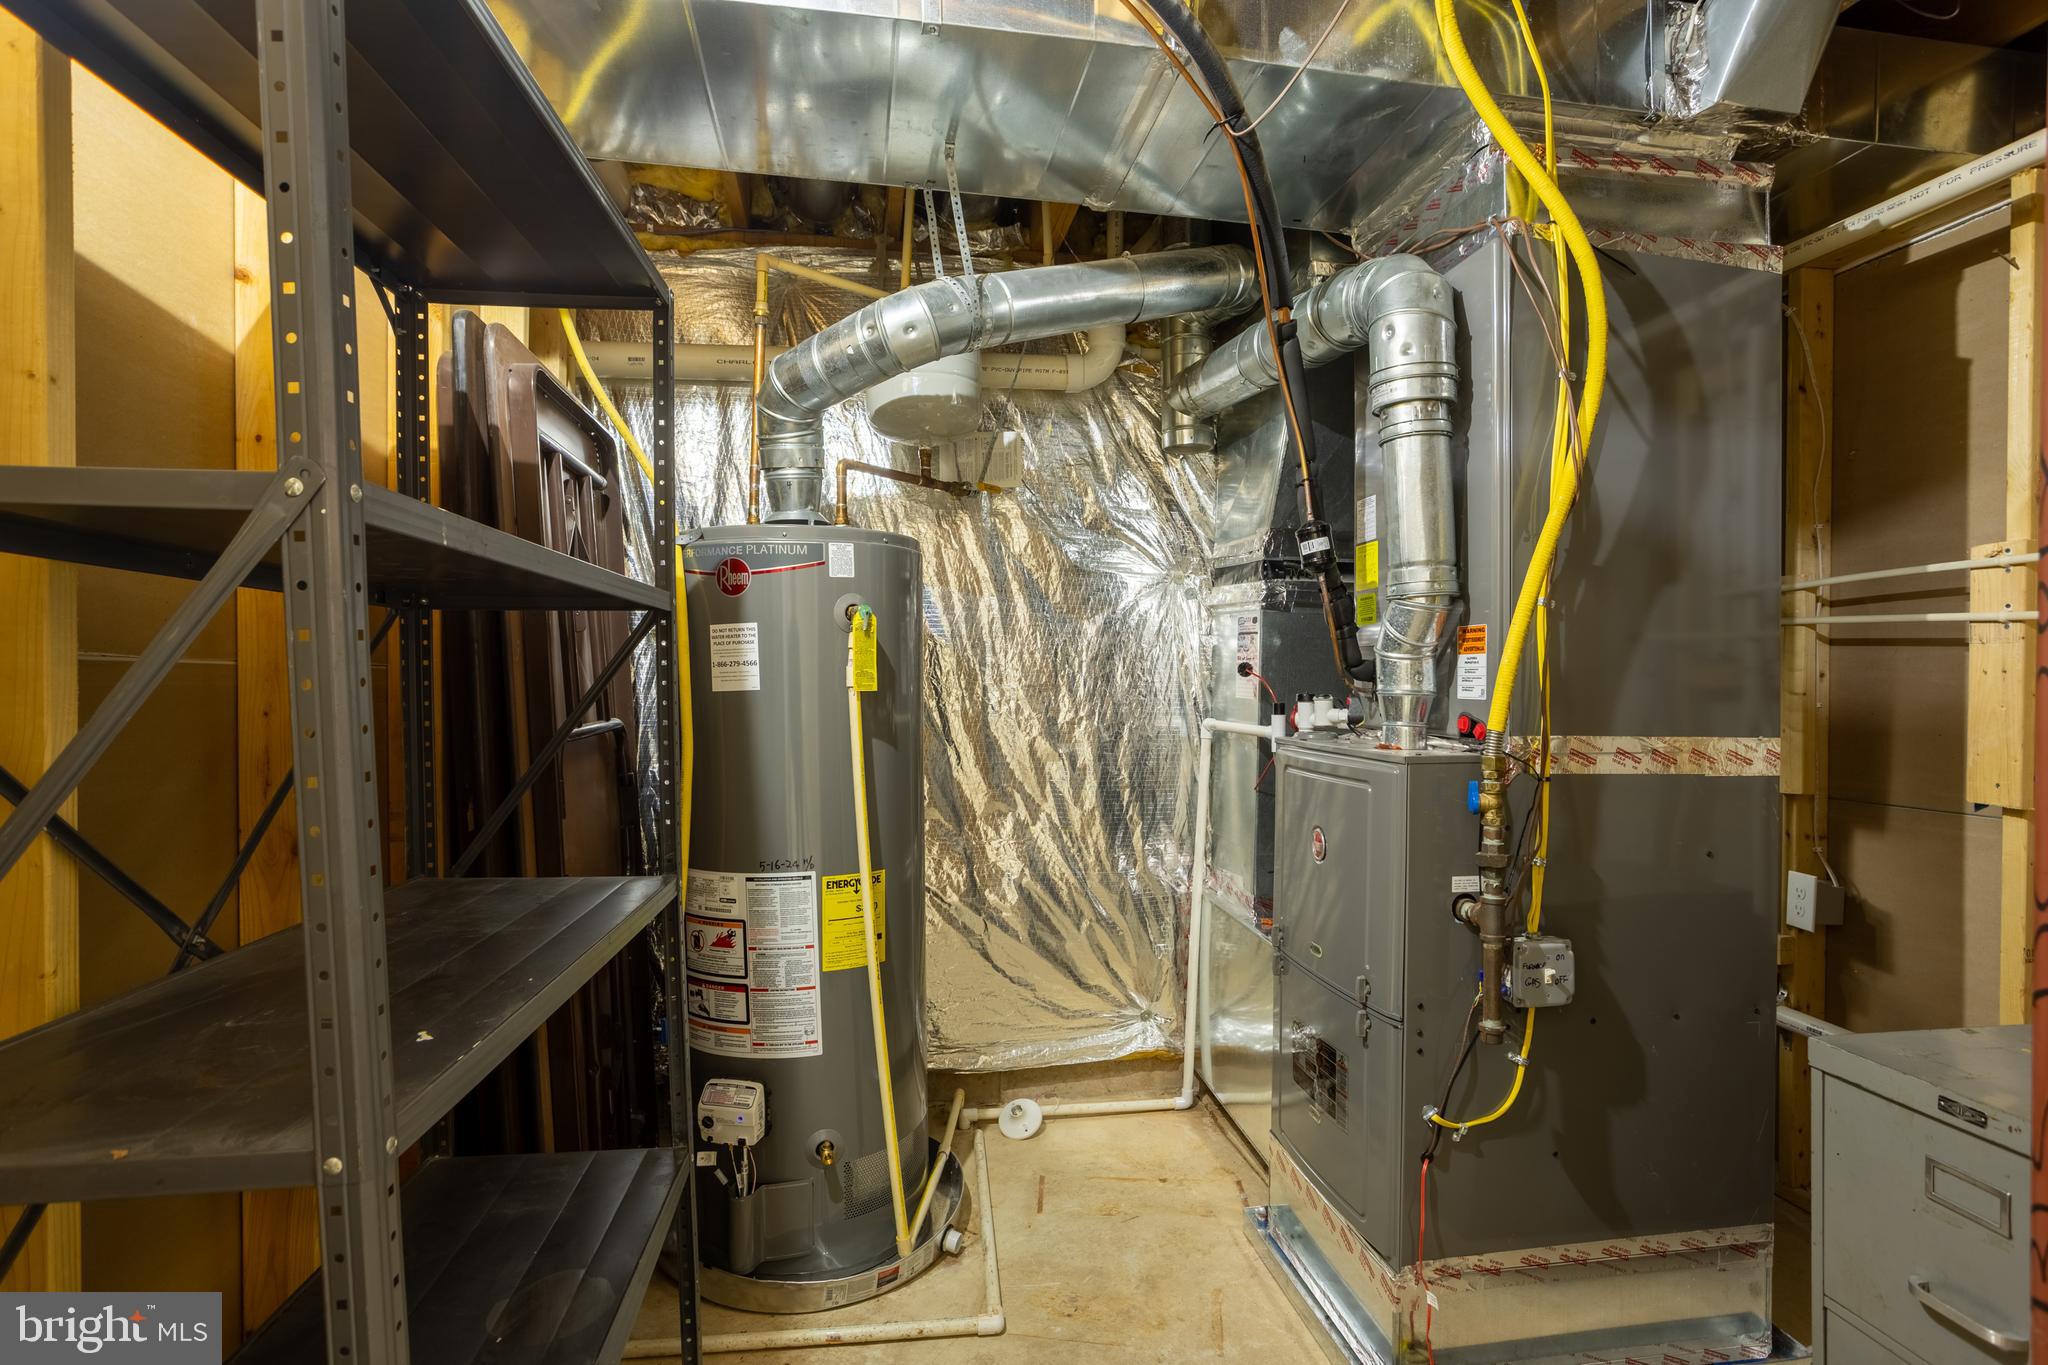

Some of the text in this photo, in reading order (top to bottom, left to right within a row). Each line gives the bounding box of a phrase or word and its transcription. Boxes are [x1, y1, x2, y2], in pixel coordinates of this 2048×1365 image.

[1909, 186, 1931, 201] NOT
[1938, 174, 1963, 189] FOR
[1969, 139, 2038, 175] PRESSURE
[746, 544, 808, 556] PLATINUM
[720, 558, 749, 590] Rheem
[712, 660, 758, 668] 1-866-279-4566
[759, 859, 800, 873] 5-16-24
